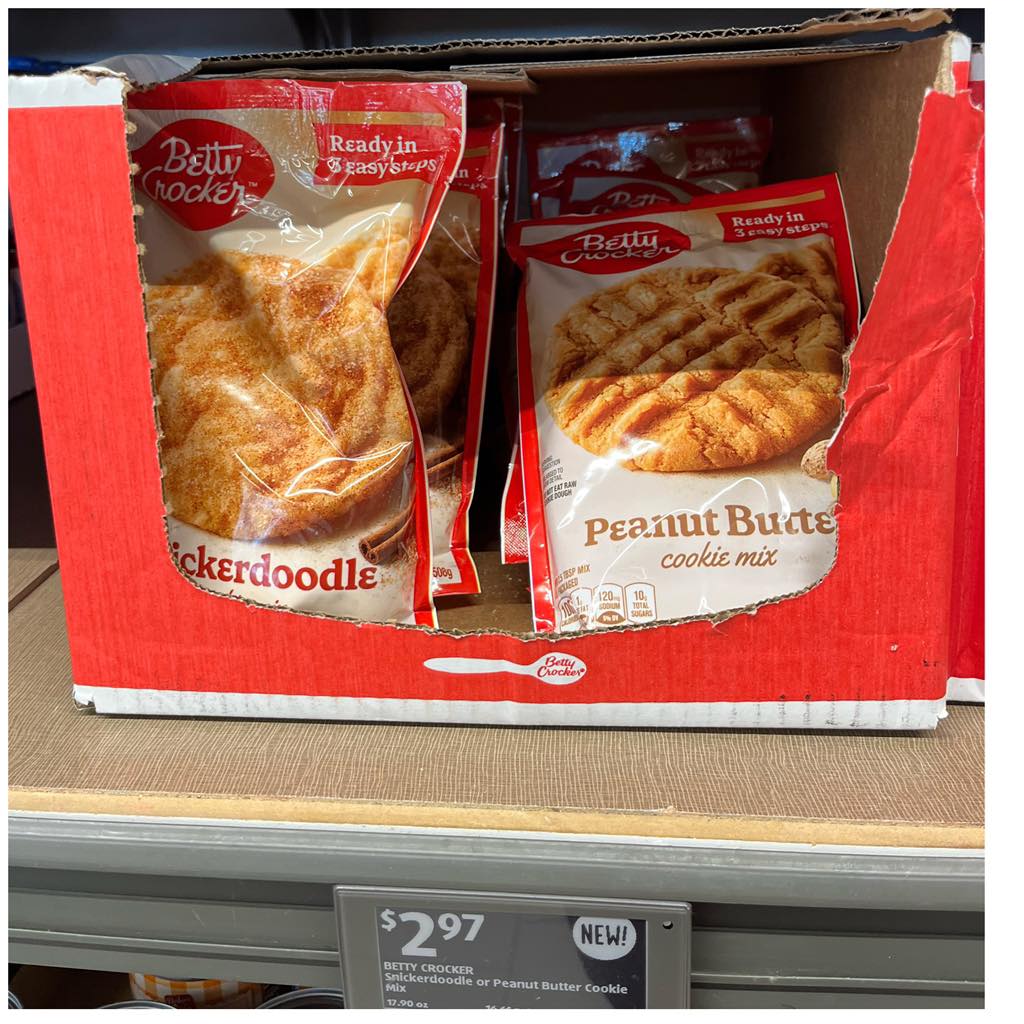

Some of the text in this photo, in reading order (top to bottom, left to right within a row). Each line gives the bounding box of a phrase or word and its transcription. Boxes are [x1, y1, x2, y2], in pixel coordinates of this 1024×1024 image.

[329, 134, 418, 158] Ready in
[159, 136, 244, 177] Betty
[345, 160, 389, 179] easy
[389, 158, 439, 175] steps
[141, 166, 247, 205] Crocker
[731, 211, 805, 227] Ready in
[734, 221, 829, 238] 3 easy steps
[574, 229, 661, 251] Betty
[560, 243, 684, 265] Crocker
[563, 479, 578, 489] RAW
[554, 488, 573, 500] DOUGH
[584, 503, 837, 548] Peanut Butte
[660, 541, 779, 570] cookie mix
[172, 541, 379, 592] ickerdoodle
[577, 563, 591, 575] MIX
[631, 609, 653, 618] SUGARS
[632, 601, 649, 609] TOTAL
[537, 665, 584, 678] Crocker
[545, 656, 576, 670] Betty
[580, 923, 628, 947] NEW!
[383, 961, 474, 975] BETTY CROCKER
[384, 972, 629, 995] Snickerdoodle or Peanut Butter Cookie
[385, 983, 407, 993] Mix
[386, 998, 414, 1007] 17.90
